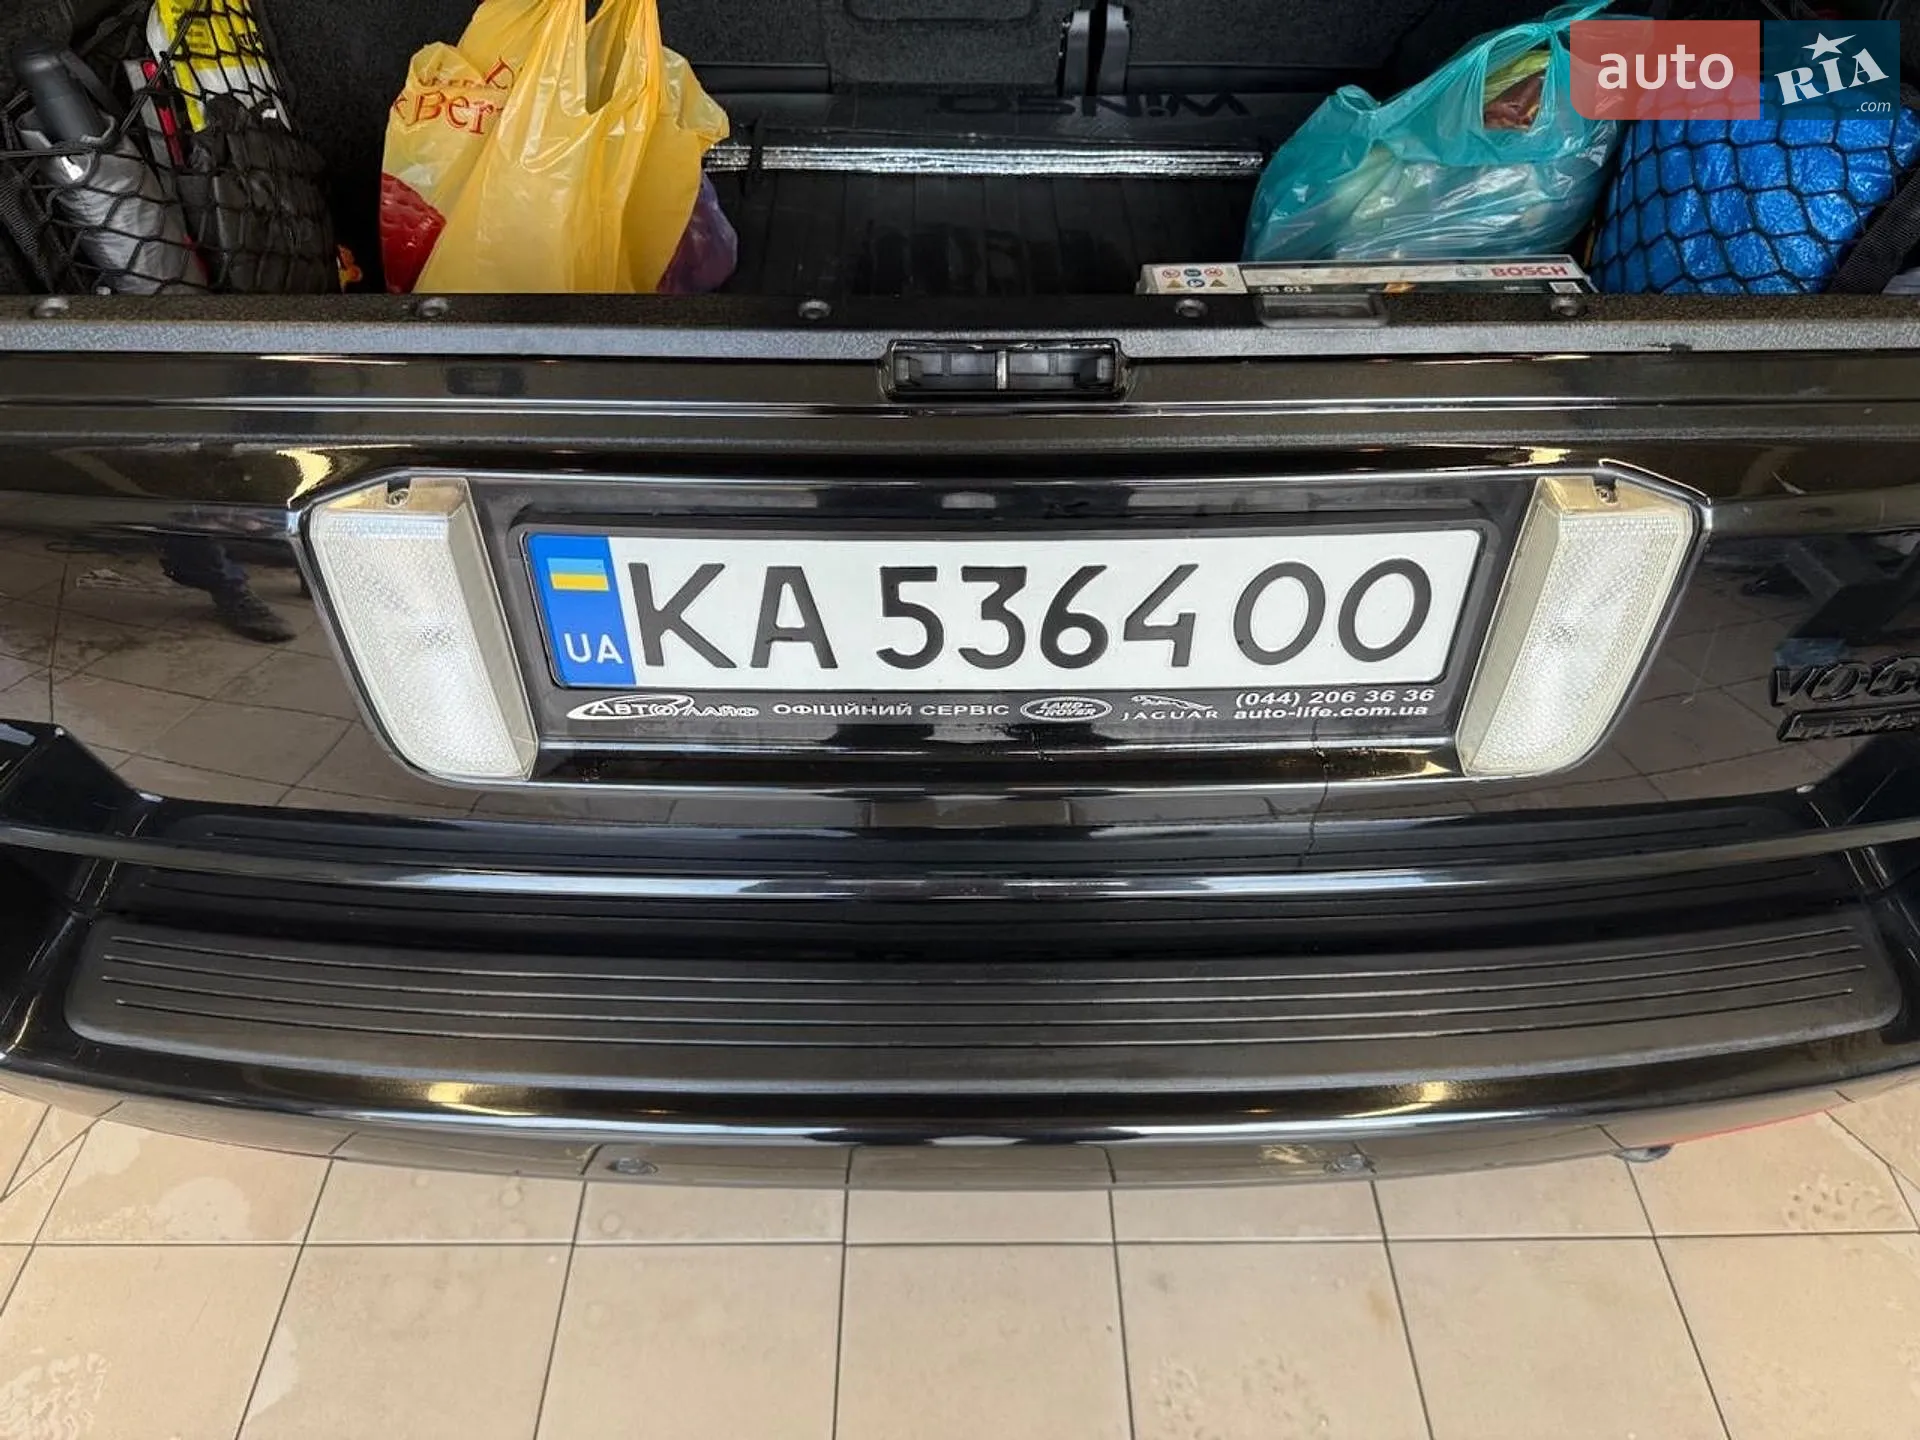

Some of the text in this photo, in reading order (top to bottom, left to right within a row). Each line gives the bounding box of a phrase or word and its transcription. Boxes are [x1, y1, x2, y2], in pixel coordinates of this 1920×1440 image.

[1491, 265, 1568, 277] BOSCH
[627, 557, 1433, 670] KA 5364 OO
[563, 633, 624, 665] UA
[1235, 688, 1436, 708] (044) 206 36 36
[772, 702, 1010, 717] ОФІЦІЙНИЙ СЕРВІС
[1121, 710, 1219, 721] JAGUAR
[1234, 705, 1429, 720] auto-life.com.ua
